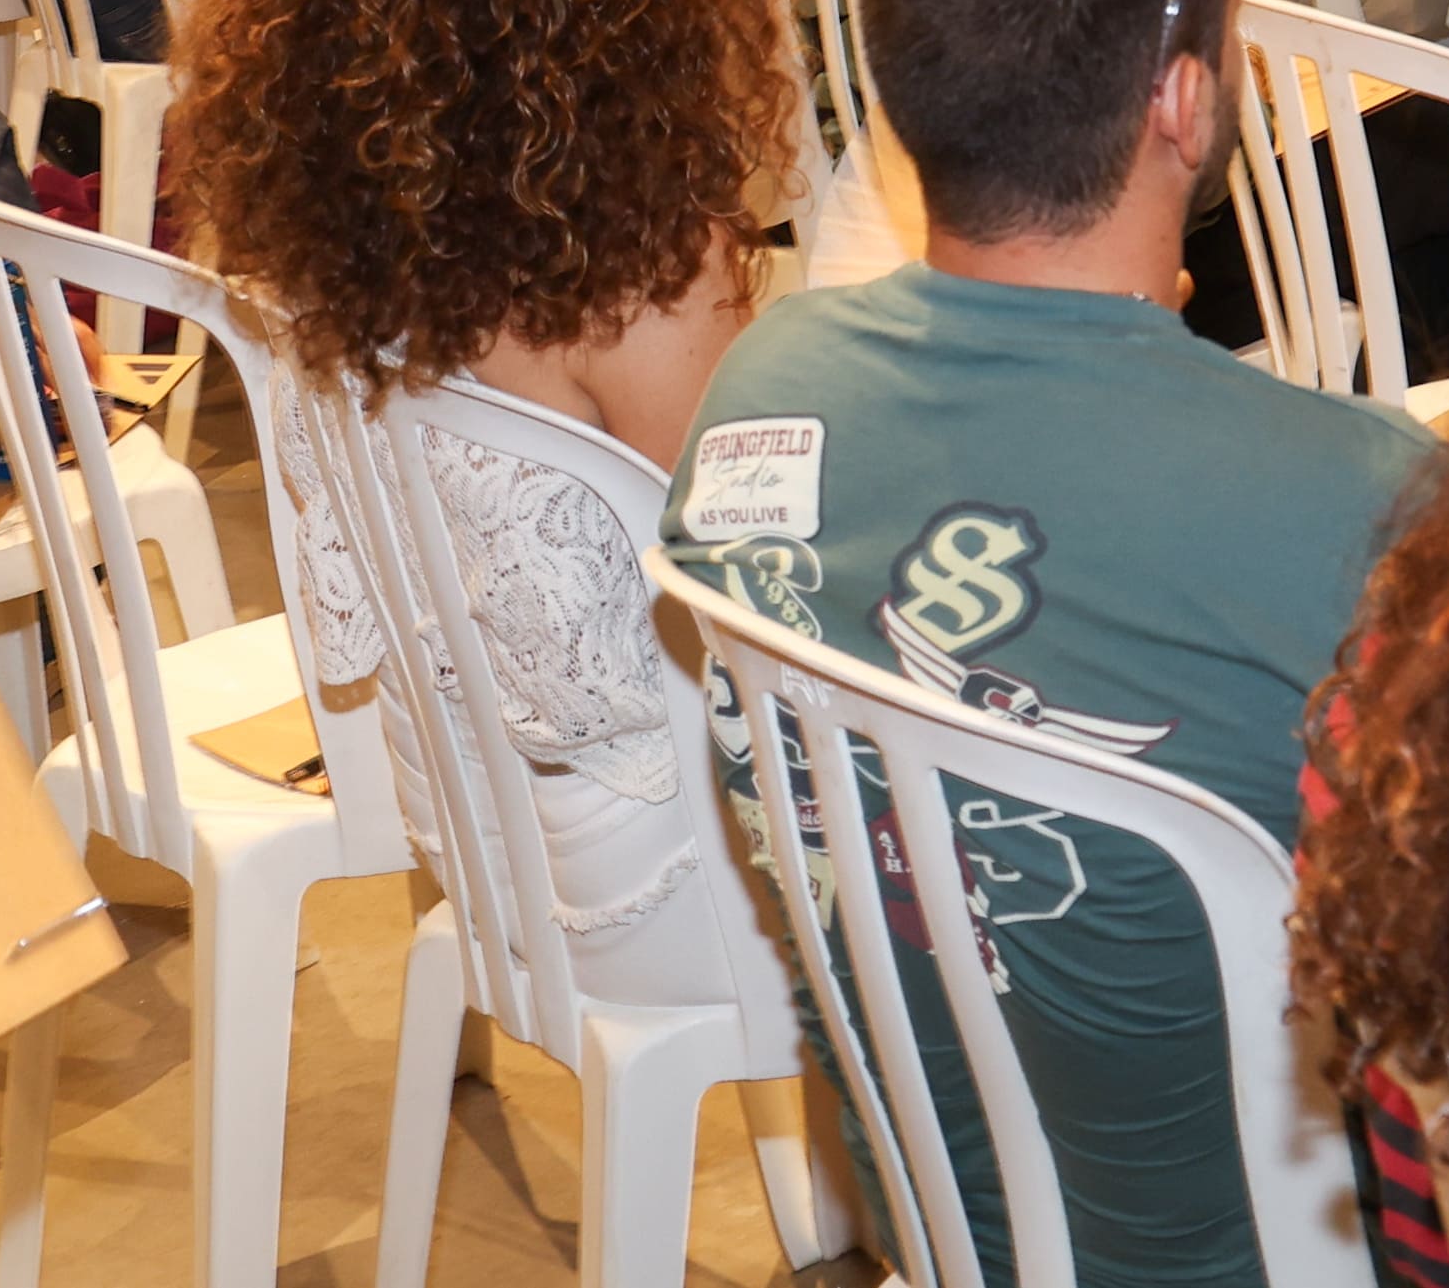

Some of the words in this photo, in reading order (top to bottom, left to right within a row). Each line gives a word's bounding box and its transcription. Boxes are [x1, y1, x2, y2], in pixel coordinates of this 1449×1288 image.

[699, 429, 814, 466] SPRINGFIELD
[700, 509, 717, 526] AS
[720, 508, 752, 525] YOU
[751, 506, 788, 523] LIVE
